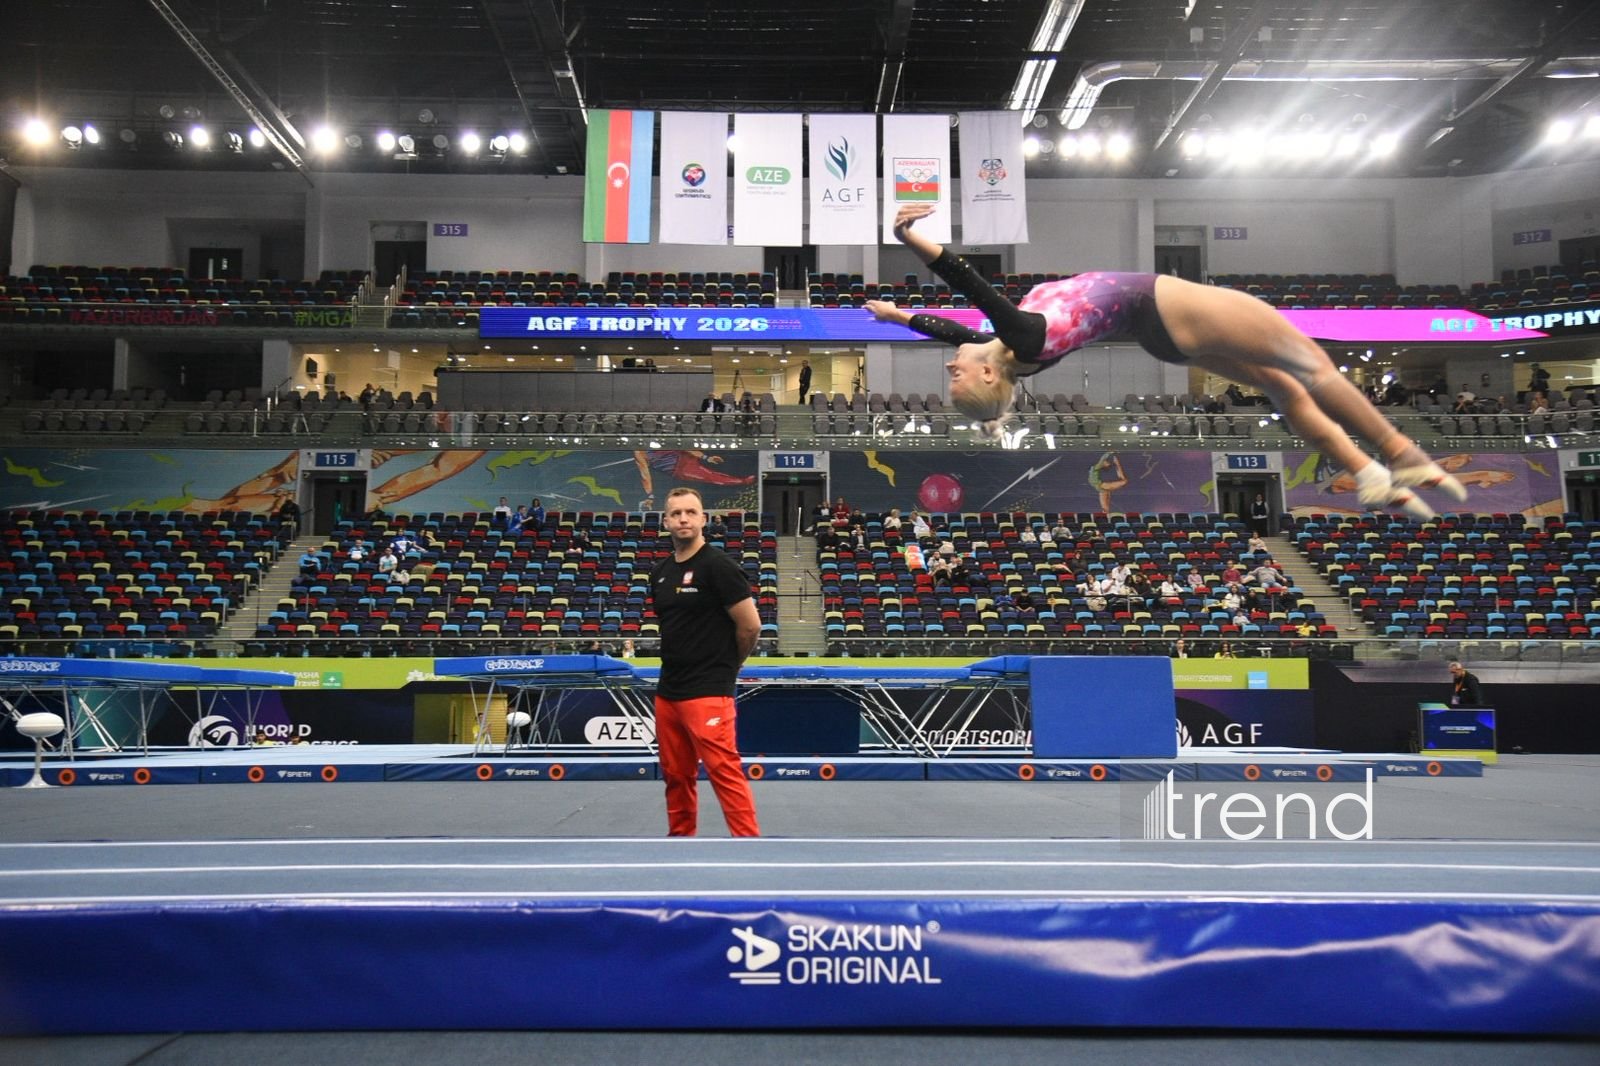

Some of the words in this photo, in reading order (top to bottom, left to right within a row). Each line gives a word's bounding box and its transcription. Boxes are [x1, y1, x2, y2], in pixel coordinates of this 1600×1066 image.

[752, 169, 783, 182] AZE
[821, 187, 865, 203] AGF
[441, 225, 461, 235] 315
[1221, 228, 1241, 239] 313
[527, 316, 577, 331] AGF
[588, 316, 688, 331] TROPHY
[697, 316, 769, 331] 2026
[1430, 318, 1478, 332] AGF
[324, 454, 348, 465] 115
[783, 455, 806, 466] 114
[1236, 456, 1259, 467] 113
[597, 722, 644, 740] AZE
[1201, 723, 1264, 745] AGF
[787, 924, 922, 951] SKAKUN
[786, 956, 942, 984] ORIGINAL
